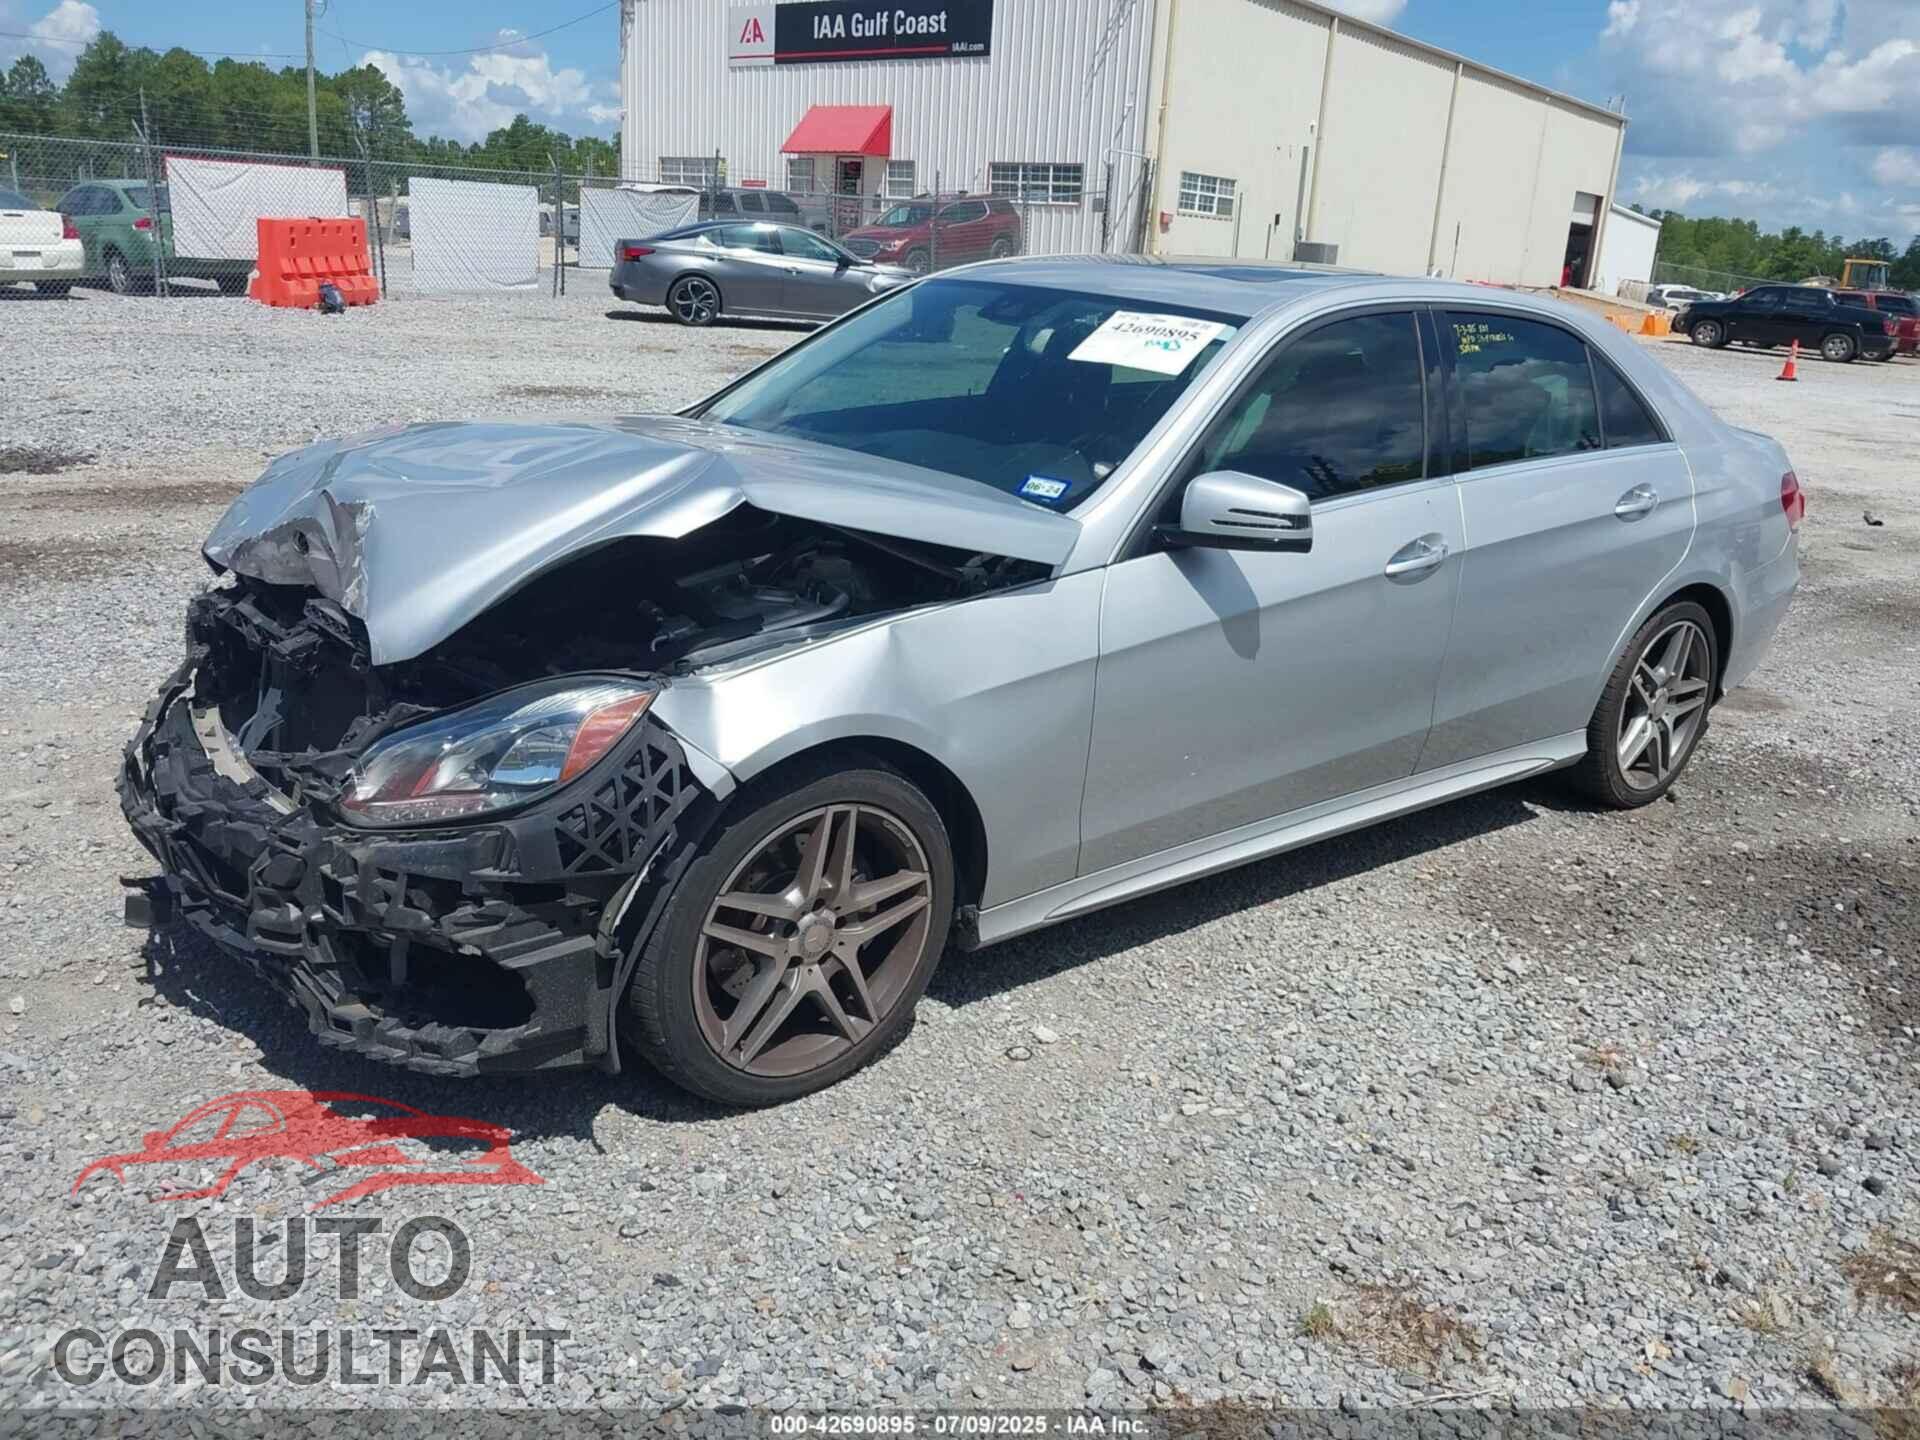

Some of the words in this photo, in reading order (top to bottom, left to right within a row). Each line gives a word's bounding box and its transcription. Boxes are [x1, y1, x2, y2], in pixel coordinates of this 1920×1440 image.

[813, 15, 846, 39] IAA
[851, 11, 888, 37] Gulf
[894, 10, 947, 35] Coast
